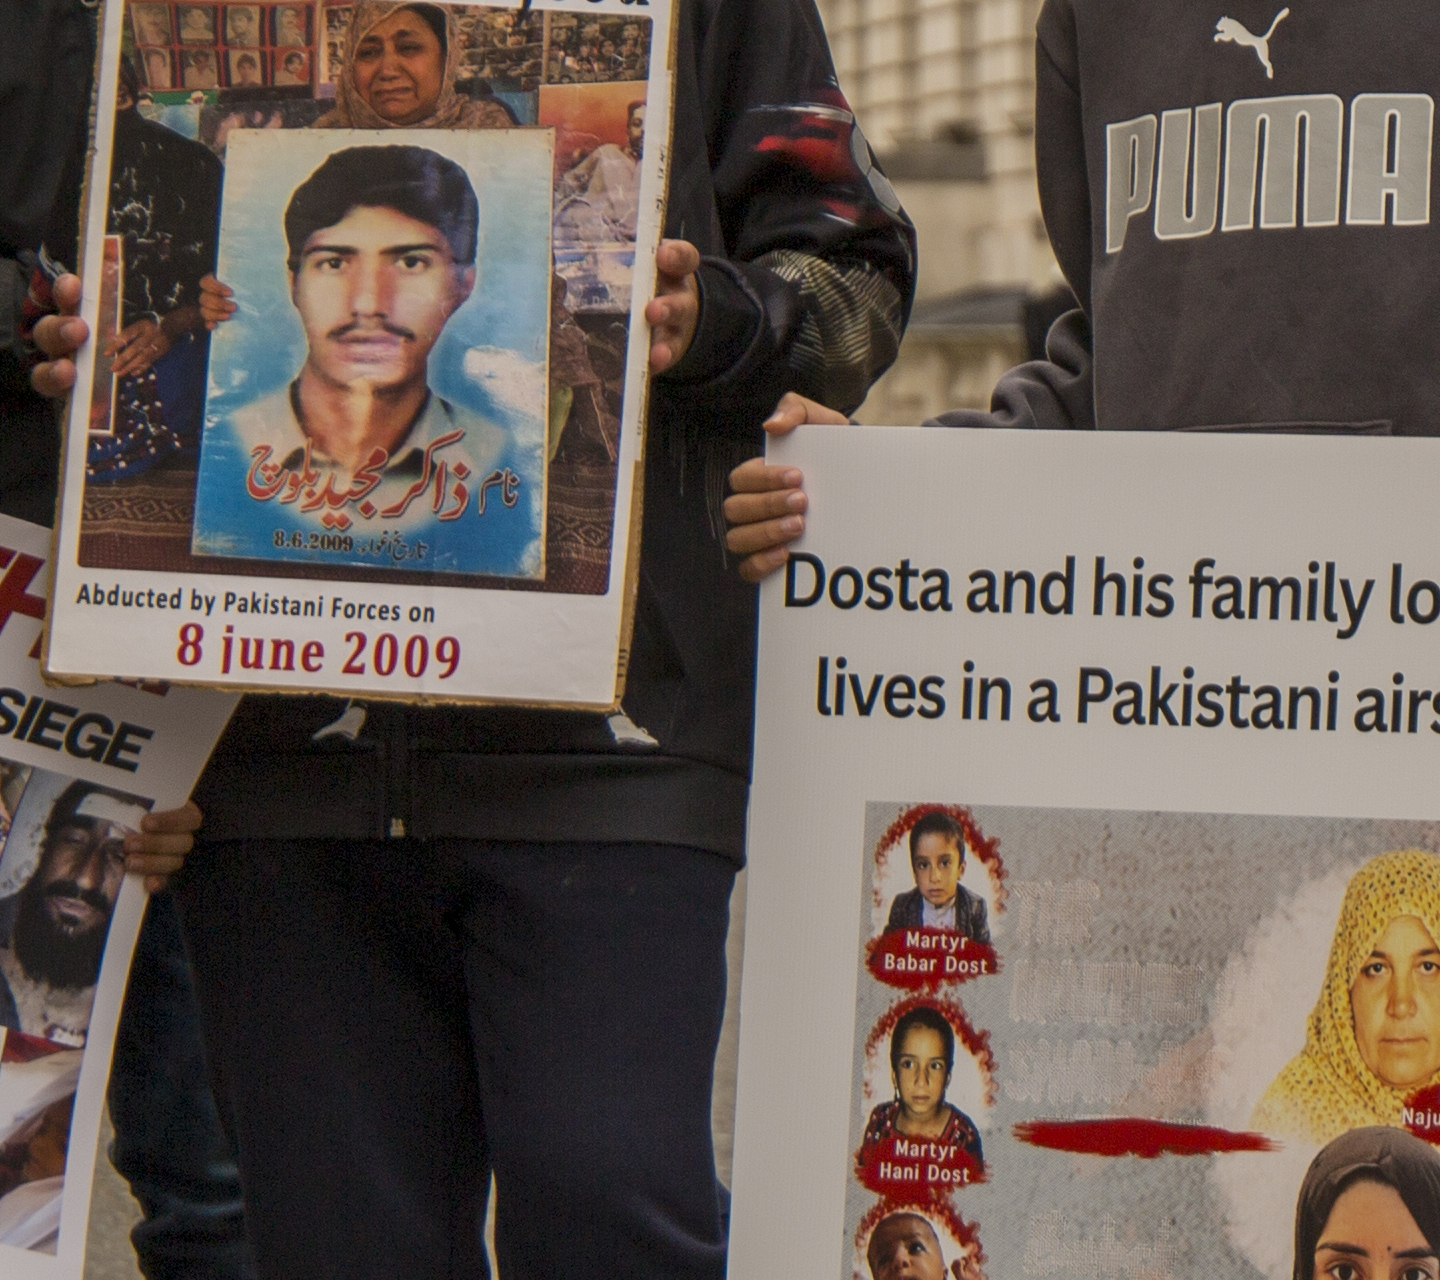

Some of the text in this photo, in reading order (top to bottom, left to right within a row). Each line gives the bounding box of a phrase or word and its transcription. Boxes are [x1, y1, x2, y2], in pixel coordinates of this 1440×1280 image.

[1106, 93, 1435, 254] PUMA
[273, 530, 354, 553] 8.6.2009
[76, 583, 435, 623] Abducted by Pakistani Forces on
[784, 551, 952, 613] Dosta
[966, 555, 1076, 615] and
[1092, 555, 1175, 618] his
[1188, 557, 1375, 639] family
[177, 623, 461, 679] 8 june 2009
[816, 655, 946, 720] lives
[961, 659, 1012, 721] in
[1027, 678, 1061, 723] a
[1077, 666, 1340, 731] Pakistani
[0, 686, 155, 773] SIEGE
[906, 931, 969, 952] Martyr
[884, 954, 988, 974] Babar Dost
[895, 1139, 958, 1161] Martyr
[880, 1164, 970, 1183] Hani Dost
